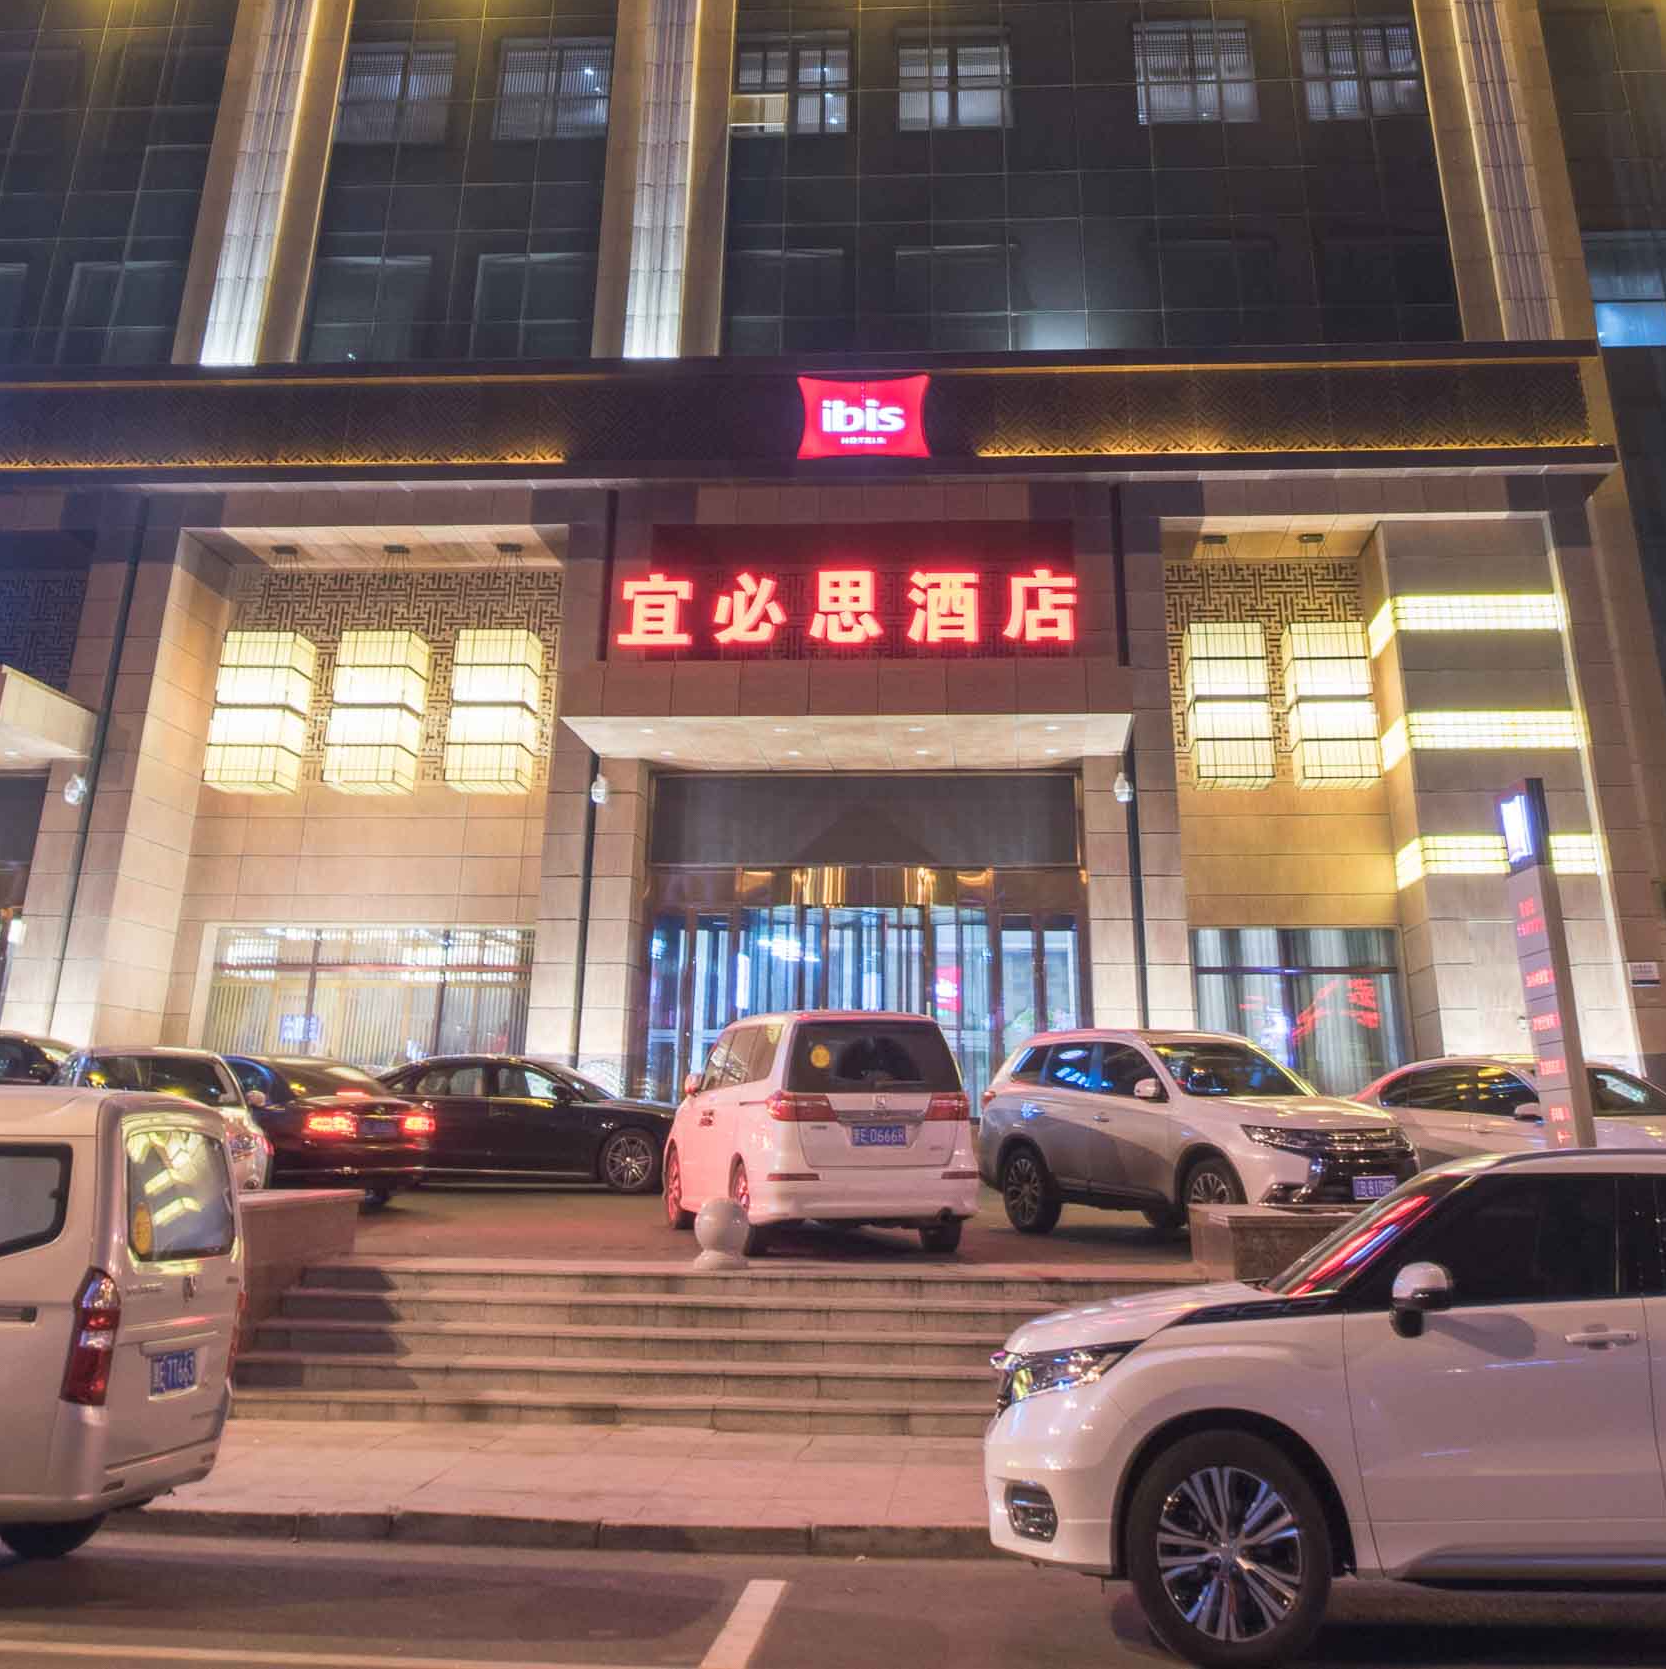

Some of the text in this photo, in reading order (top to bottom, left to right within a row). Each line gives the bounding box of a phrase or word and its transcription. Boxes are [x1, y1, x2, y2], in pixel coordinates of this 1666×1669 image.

[821, 398, 905, 433] ibis
[616, 569, 1077, 646] 宜必思酒店
